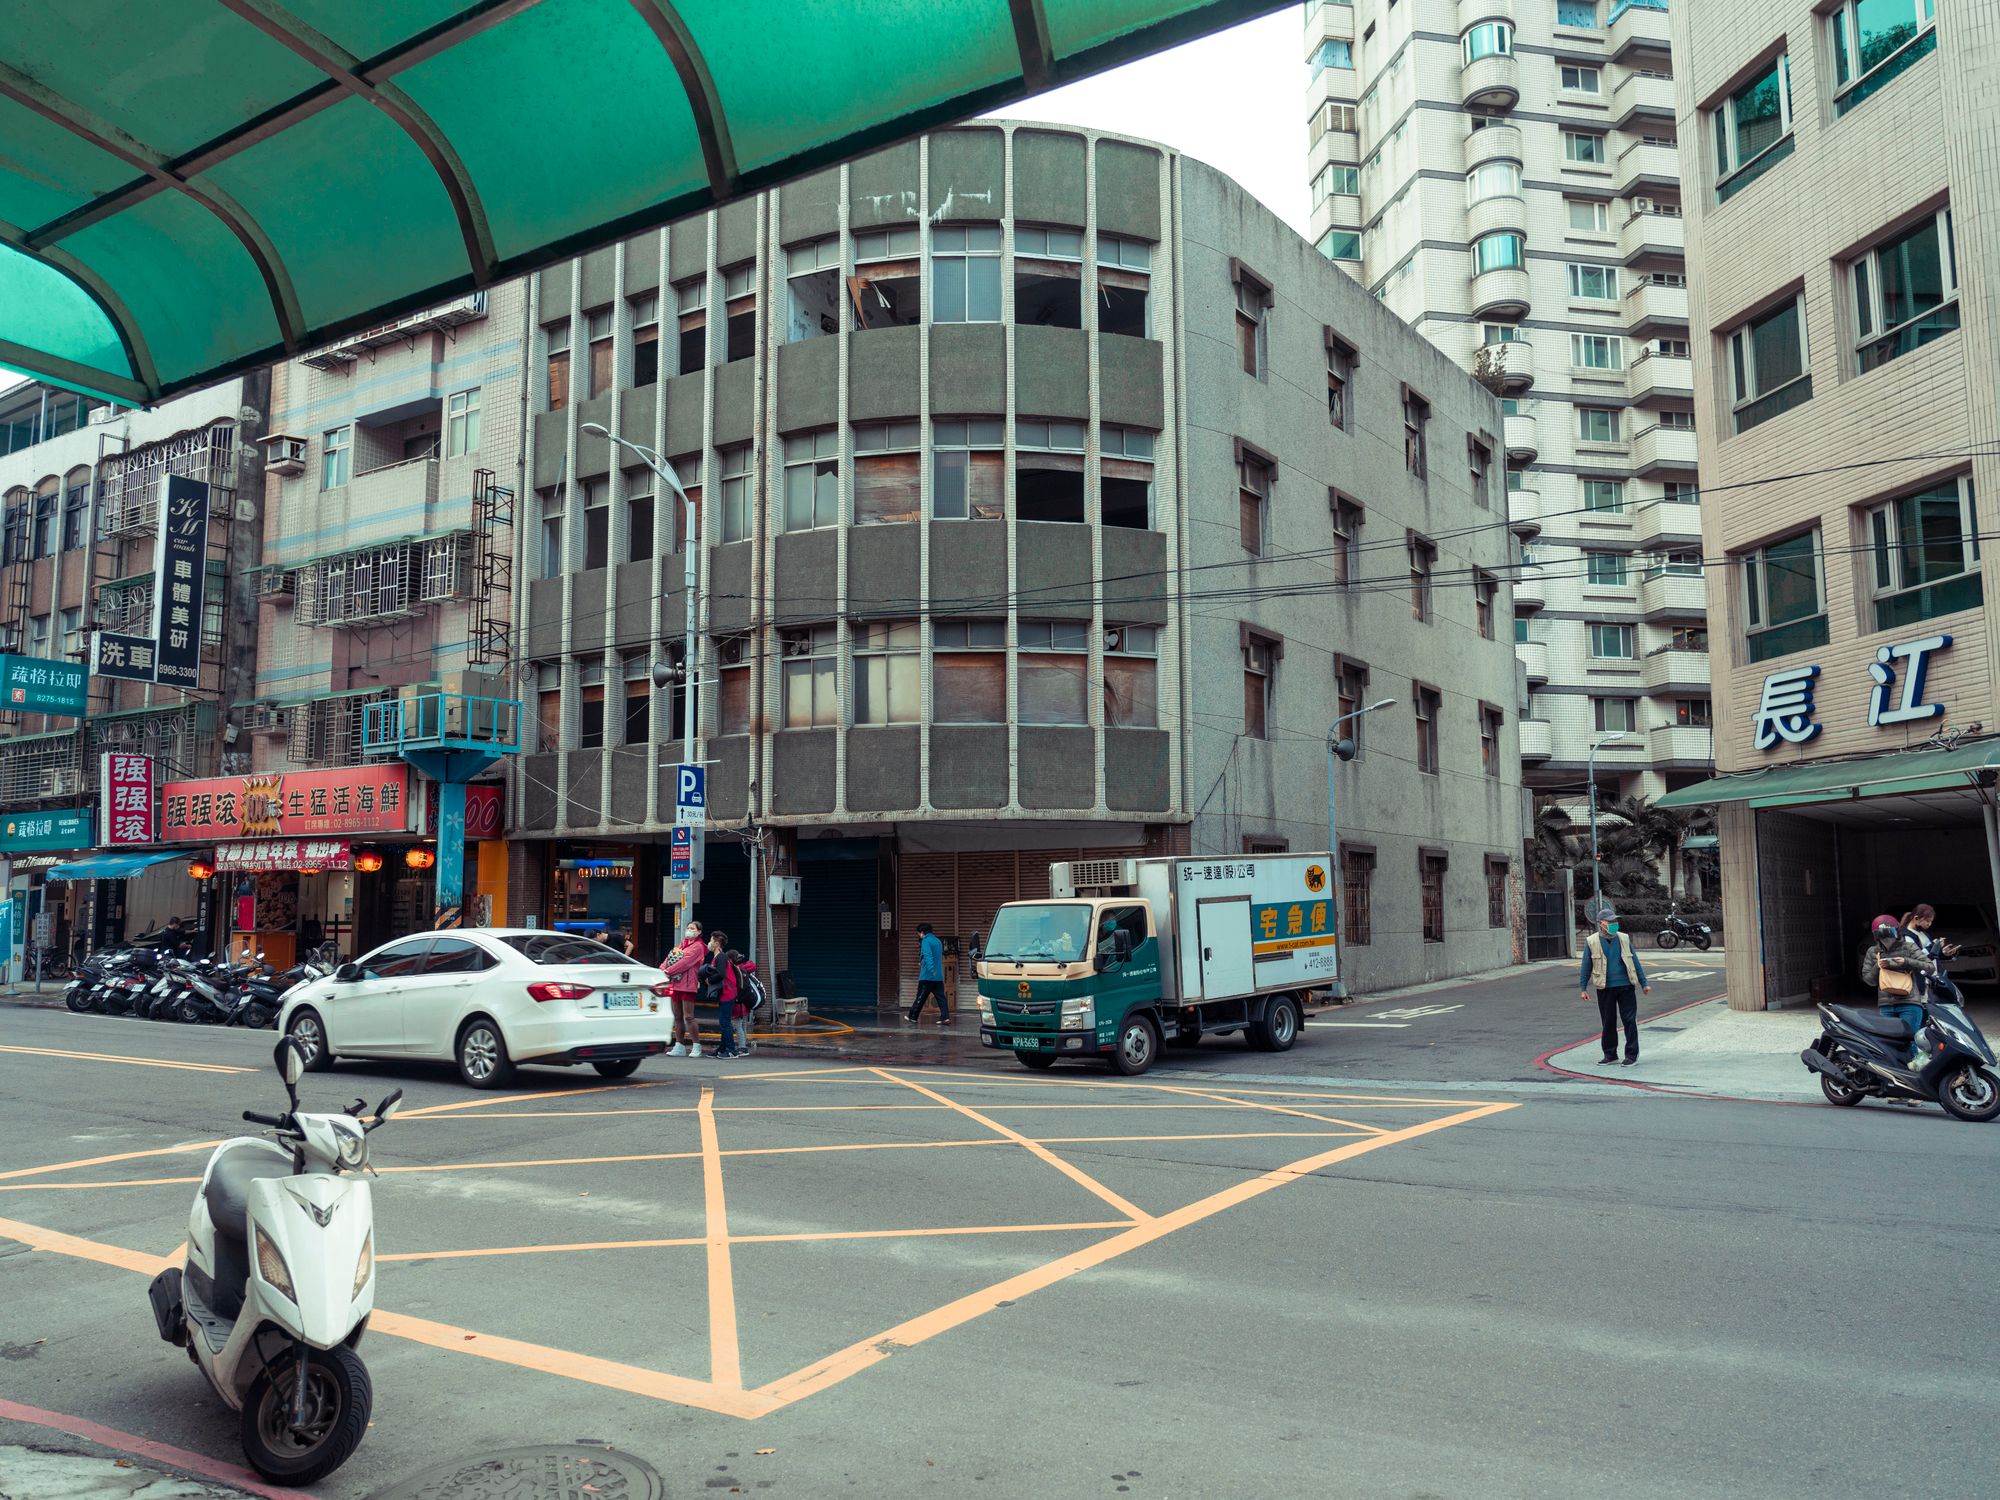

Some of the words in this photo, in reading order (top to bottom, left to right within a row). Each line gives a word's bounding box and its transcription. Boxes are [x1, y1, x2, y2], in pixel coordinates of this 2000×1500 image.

[173, 537, 189, 545] car
[173, 543, 196, 552] wash
[169, 559, 192, 650] 車體美研
[100, 640, 153, 670] 洗車
[158, 663, 197, 679] 8968-3300
[36, 694, 74, 705] 8275-1815
[1752, 635, 1953, 751] 長江
[680, 769, 697, 802] P
[1259, 902, 1327, 938] 宅急便
[1308, 956, 1333, 969] 412-8888
